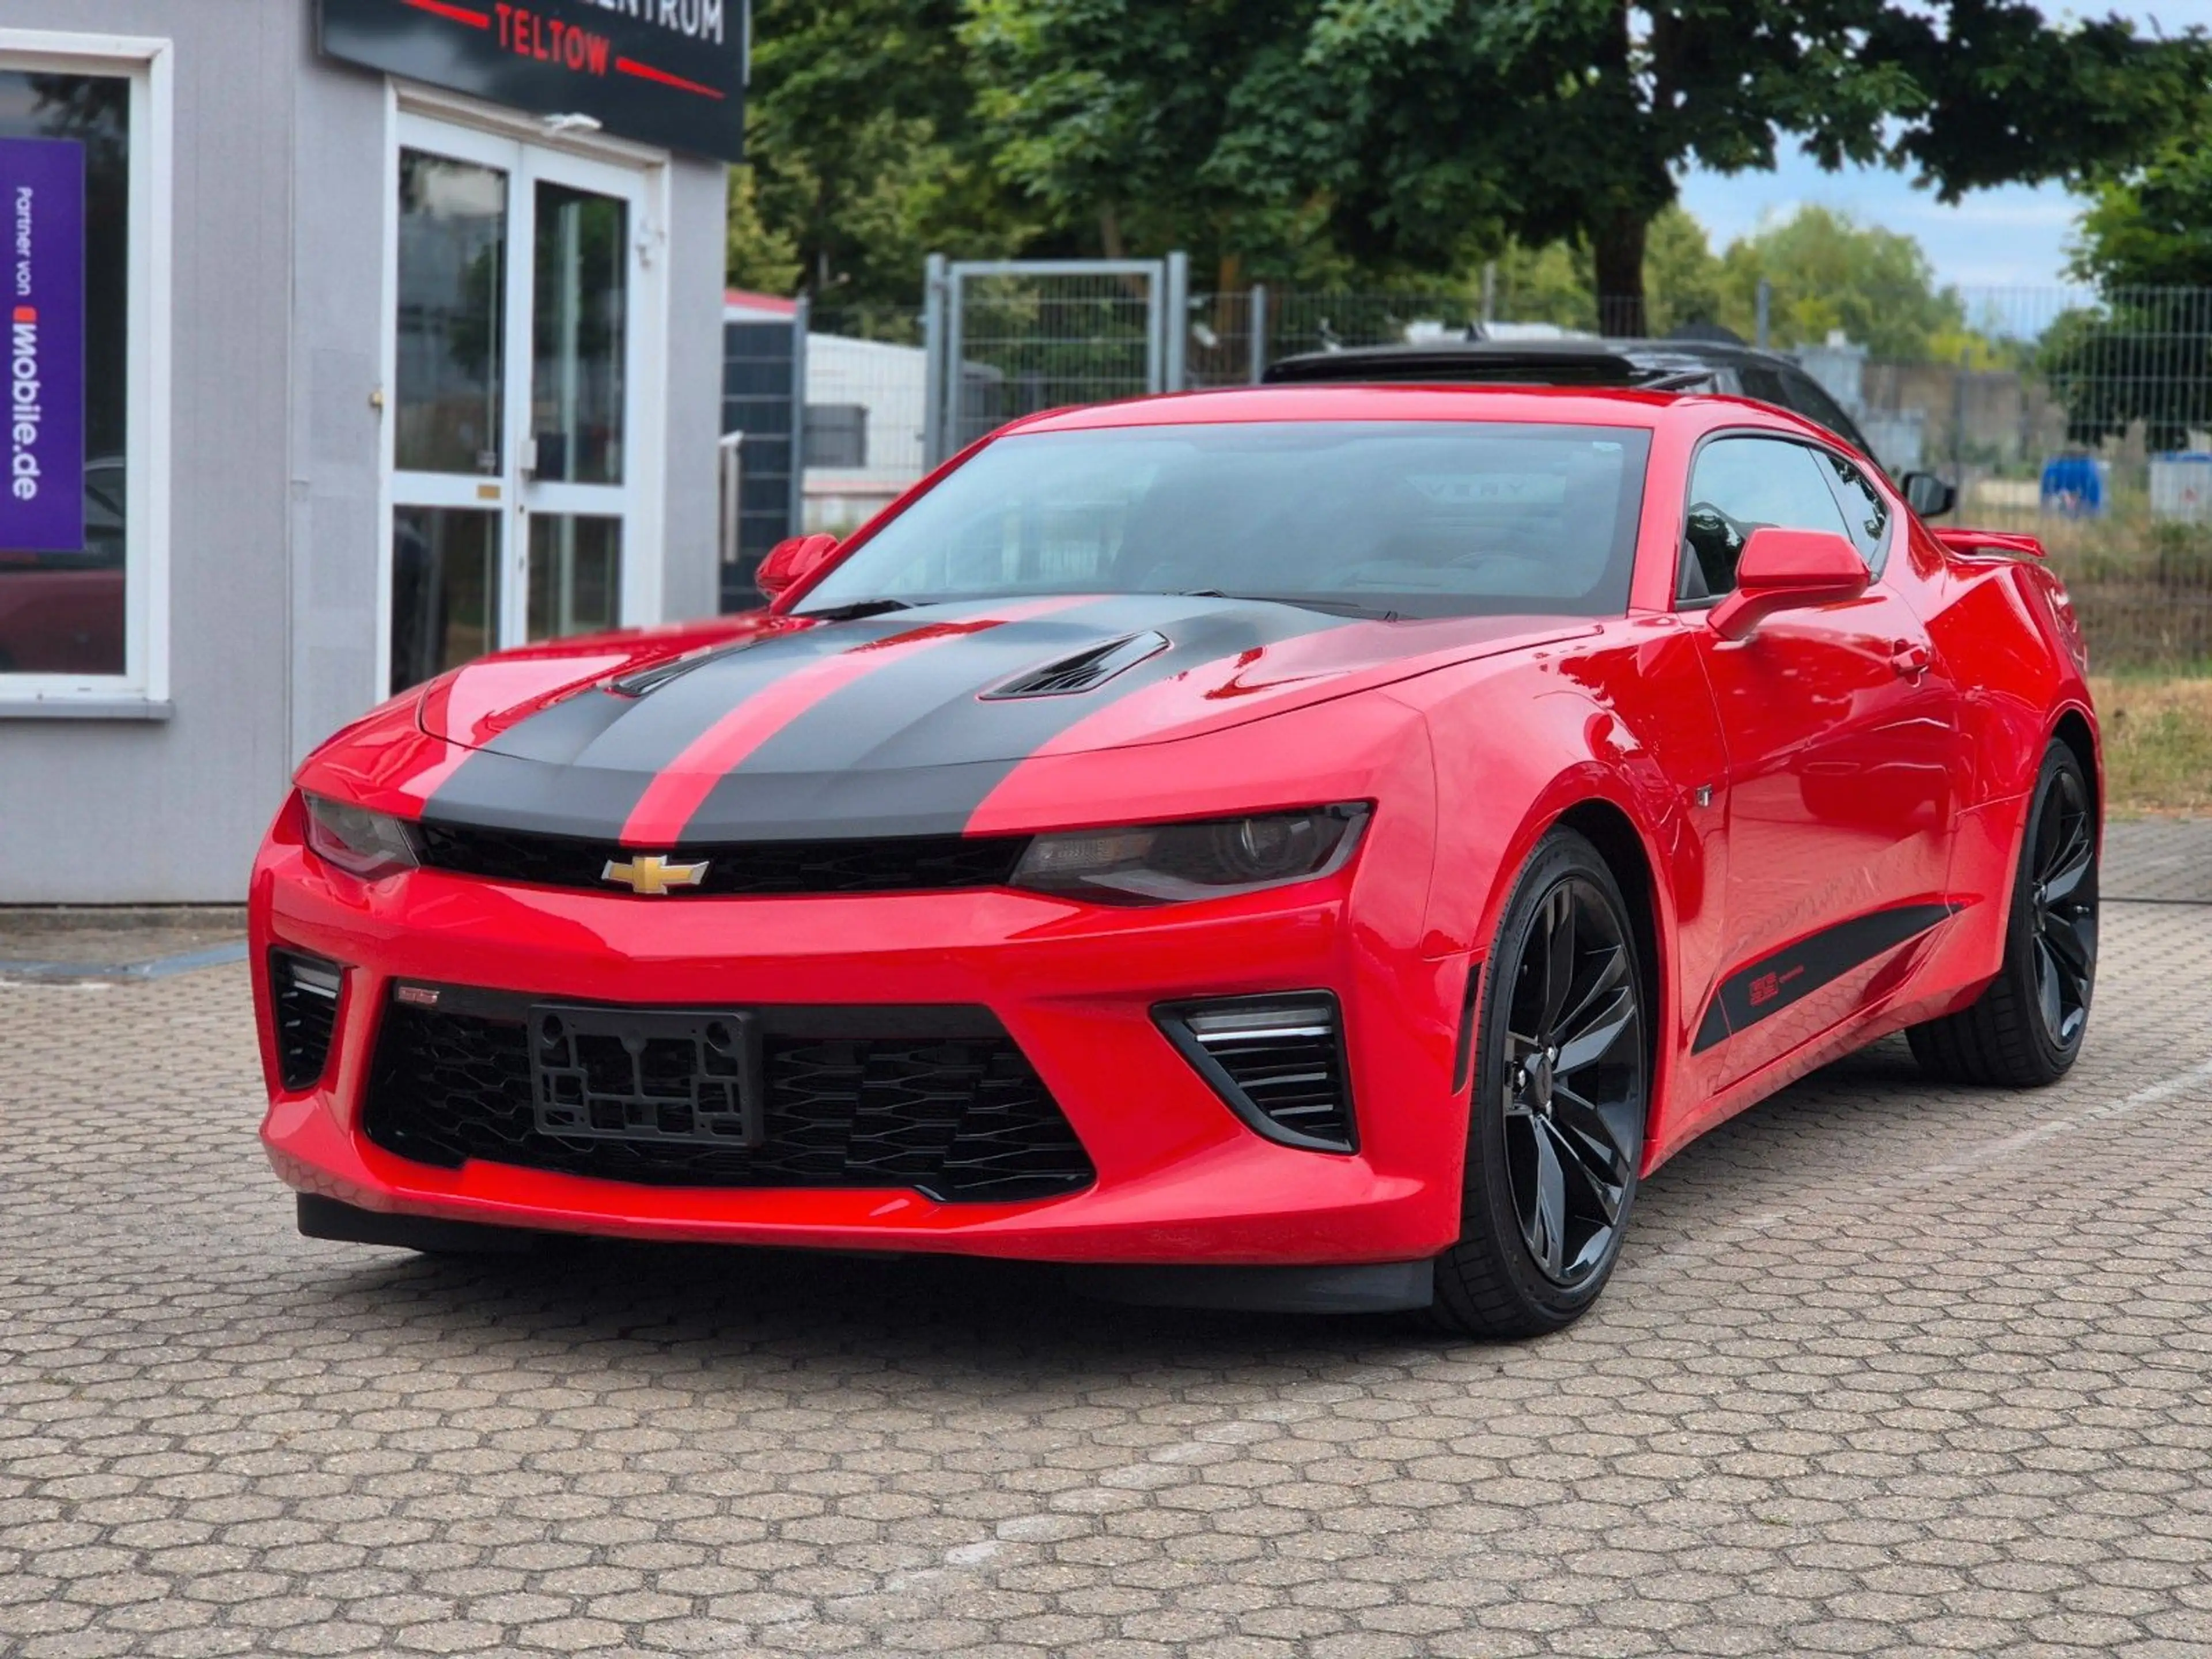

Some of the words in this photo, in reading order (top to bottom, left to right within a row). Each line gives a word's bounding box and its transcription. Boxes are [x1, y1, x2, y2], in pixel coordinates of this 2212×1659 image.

[495, 2, 611, 75] TELTOW
[16, 187, 33, 257] Partner
[17, 261, 31, 296] von
